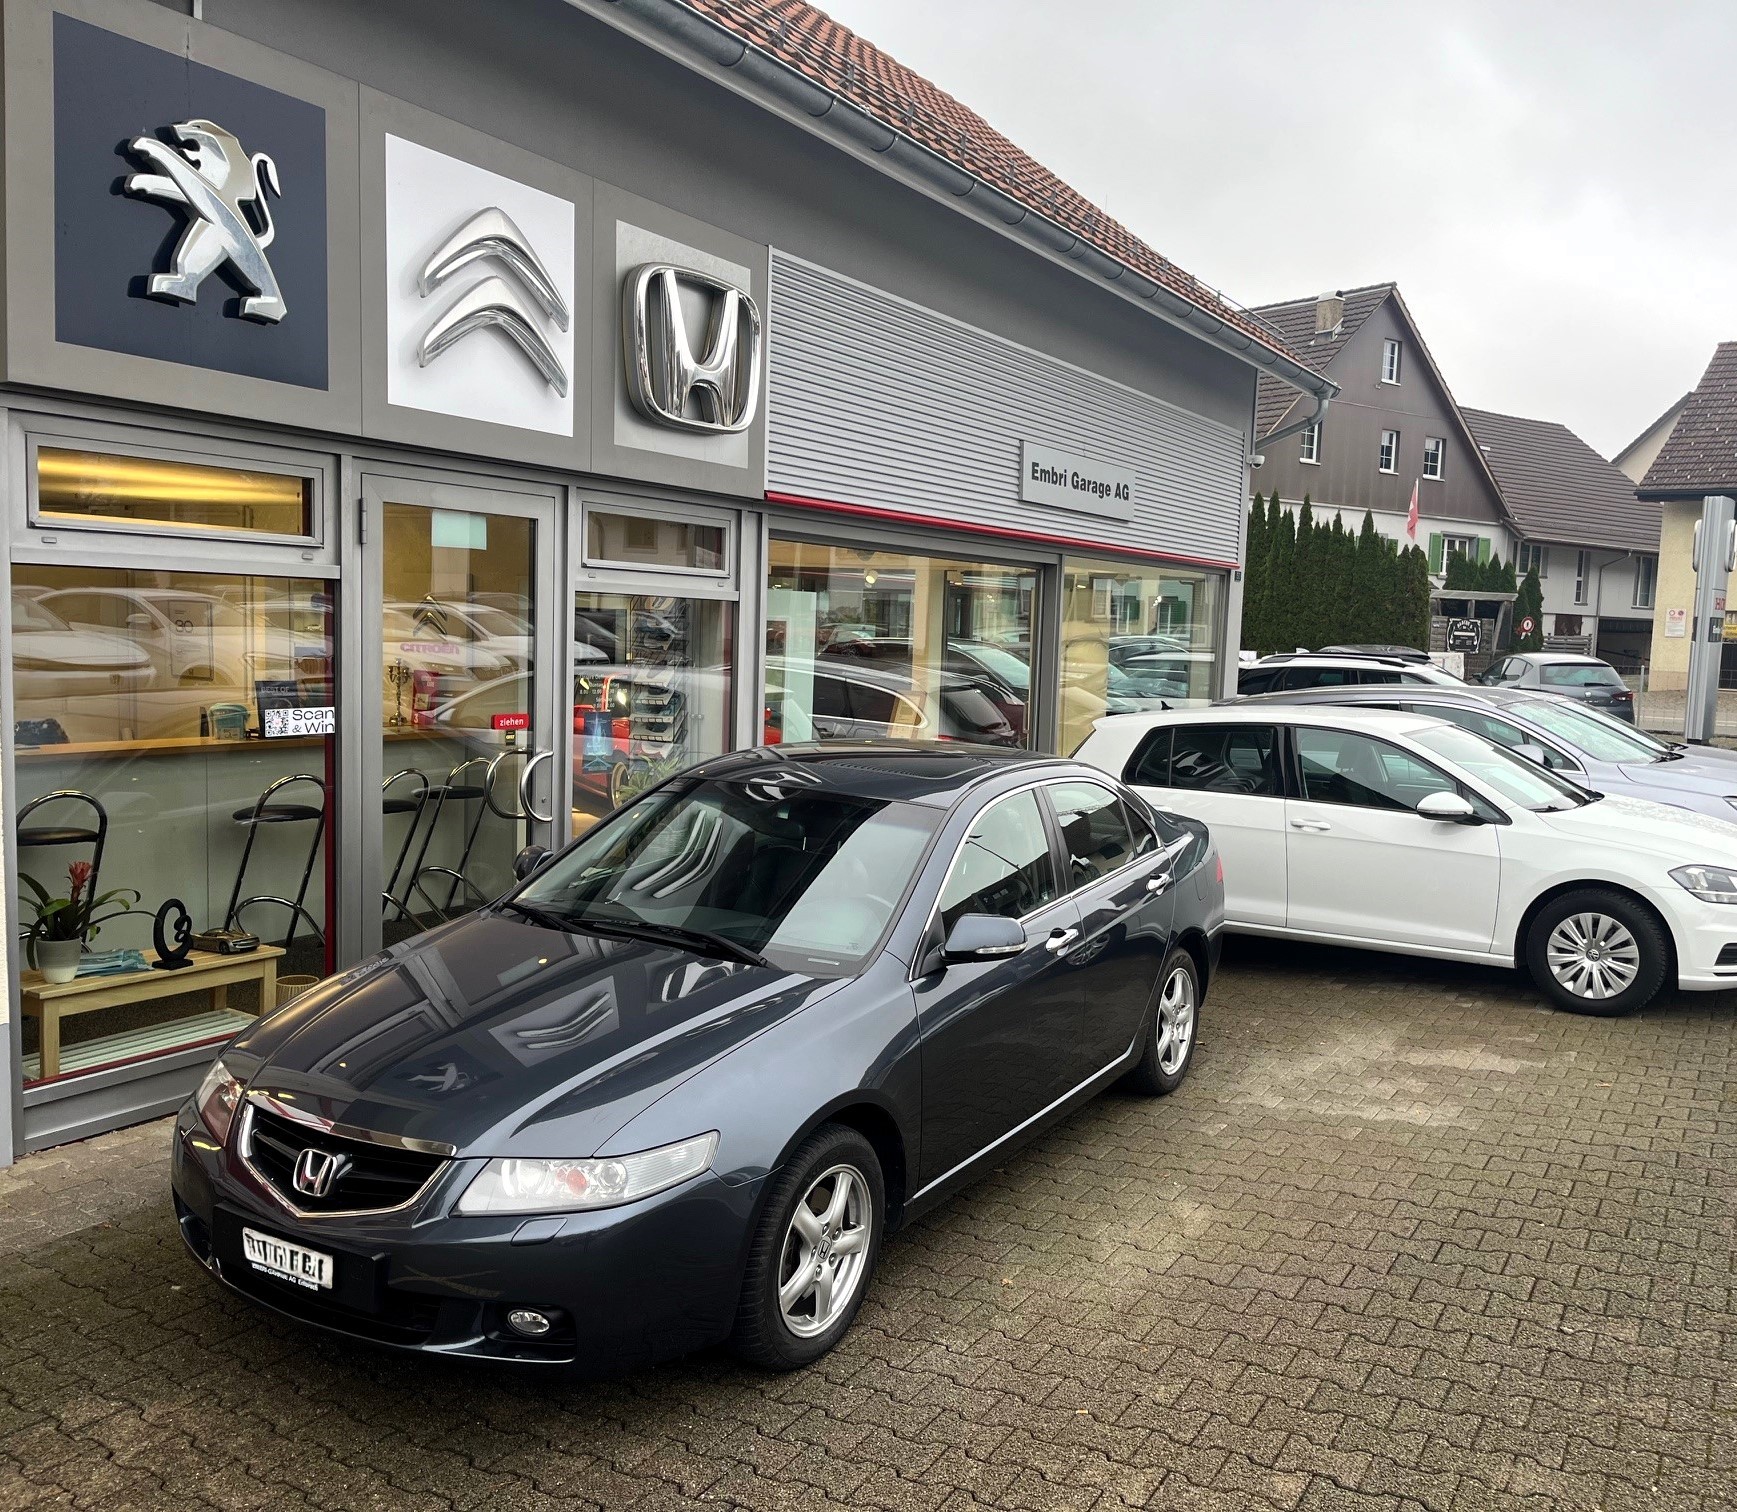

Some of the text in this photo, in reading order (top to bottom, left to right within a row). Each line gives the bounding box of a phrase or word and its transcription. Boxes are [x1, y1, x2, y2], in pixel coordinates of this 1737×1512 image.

[1031, 461, 1130, 501] Embri Garage AG
[292, 709, 335, 721] Scan
[292, 720, 335, 734] & Win
[499, 717, 524, 727] ziehen
